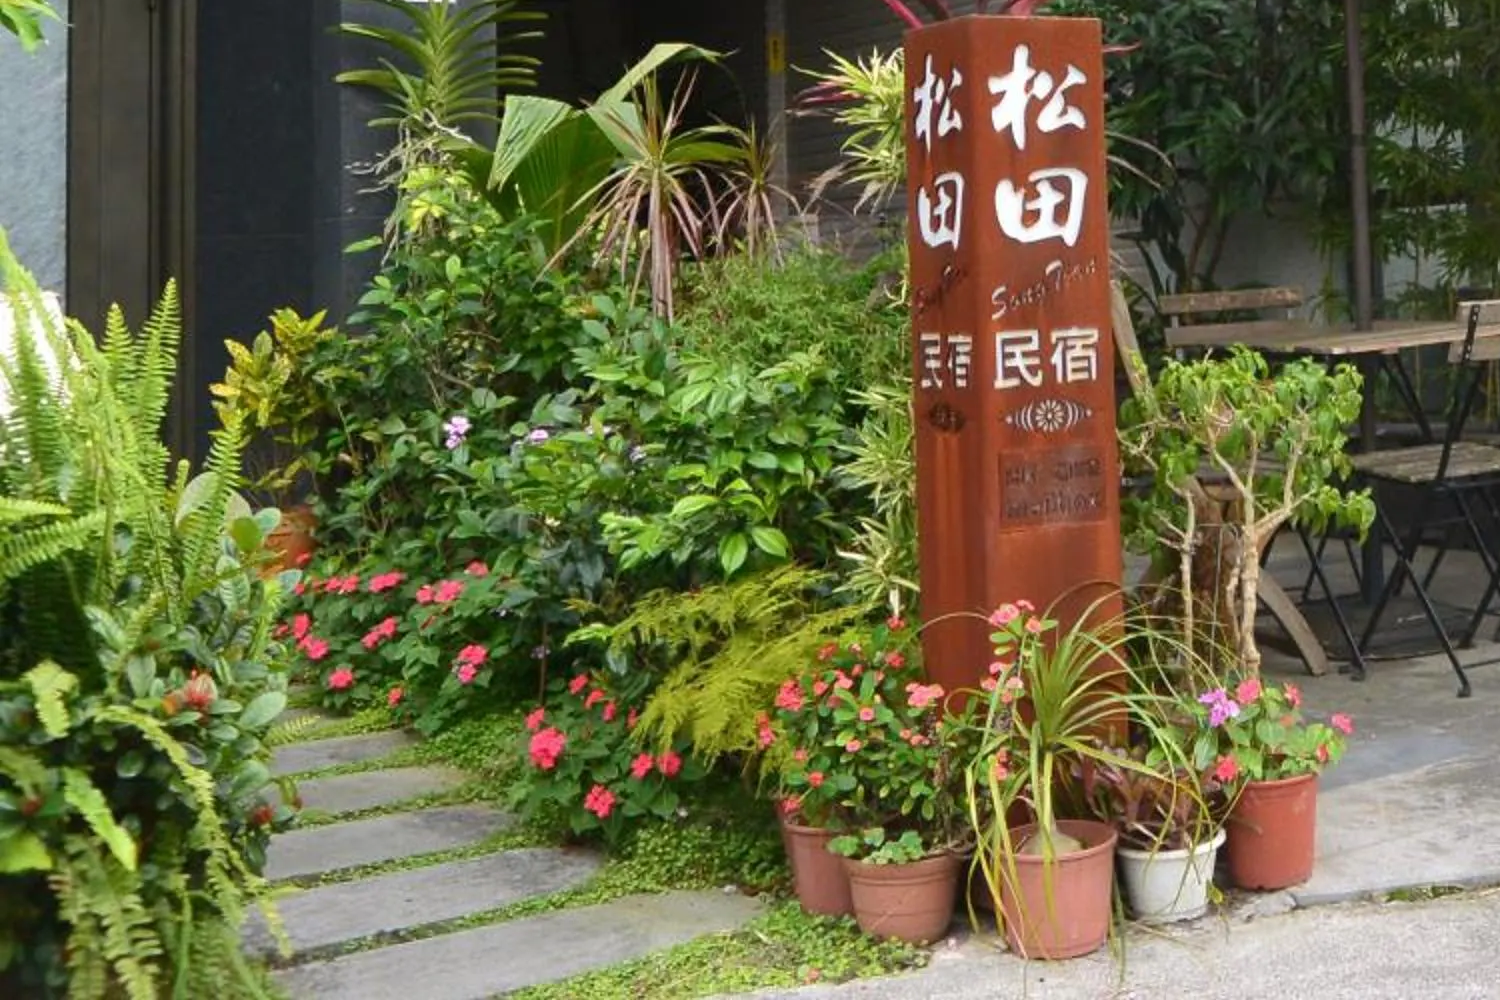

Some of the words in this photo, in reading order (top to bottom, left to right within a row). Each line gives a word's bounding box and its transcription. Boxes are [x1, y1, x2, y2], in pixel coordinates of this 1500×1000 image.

[914, 52, 966, 252] 松田
[987, 43, 1089, 248] 松田
[993, 326, 1099, 390] 民宿
